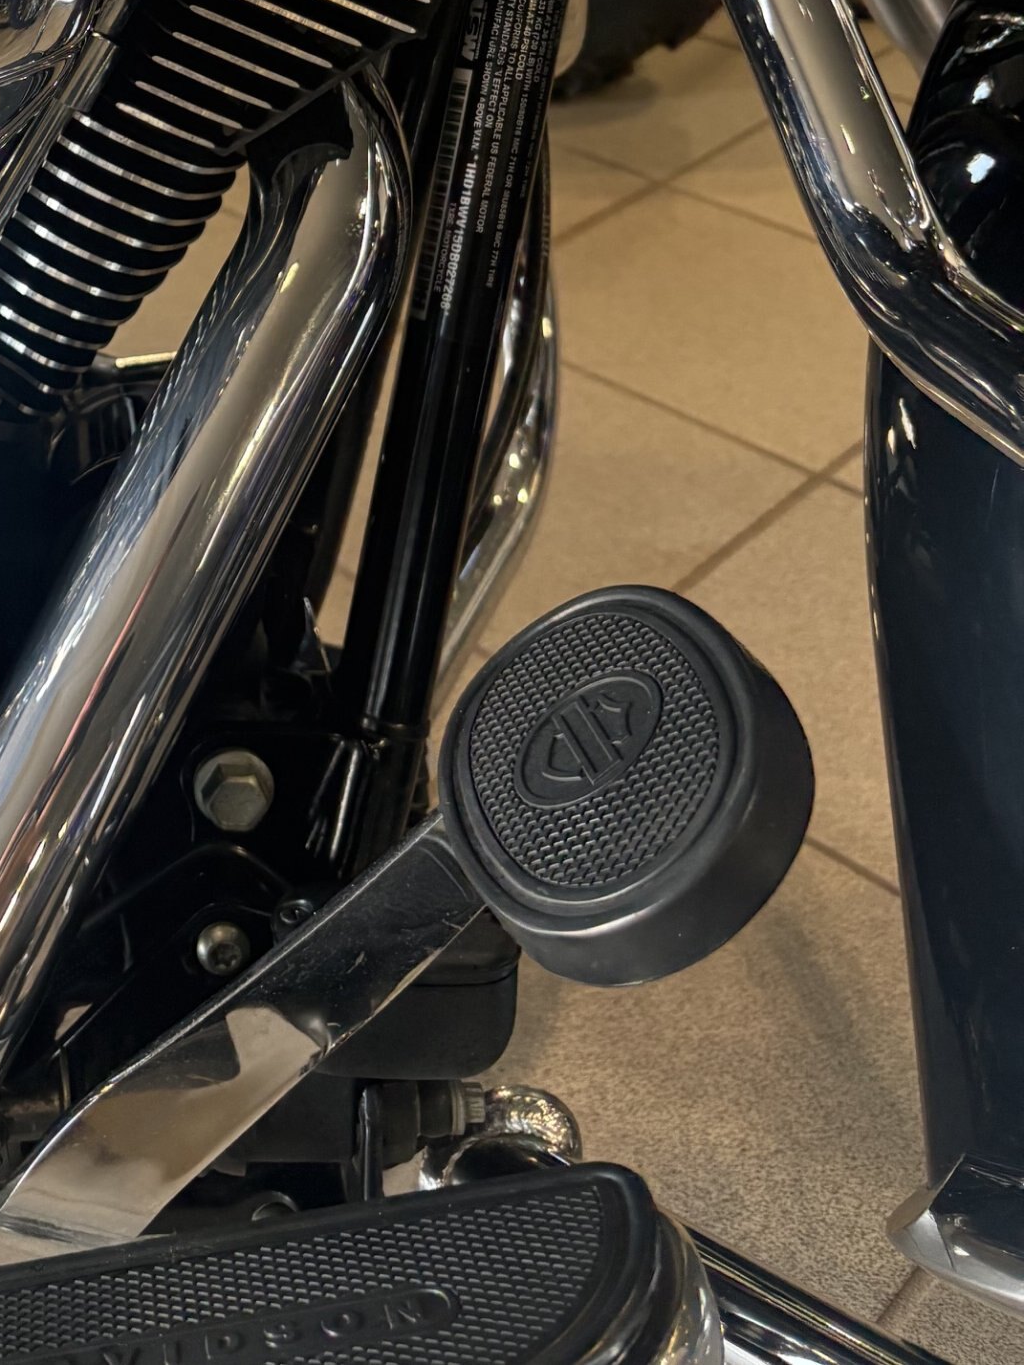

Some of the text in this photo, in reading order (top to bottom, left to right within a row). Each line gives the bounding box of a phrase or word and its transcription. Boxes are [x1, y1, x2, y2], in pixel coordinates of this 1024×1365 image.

[525, 11, 534, 24] AT
[533, 16, 543, 30] KG
[495, 9, 514, 66] STANDARDS
[519, 37, 529, 53] PSI
[506, 51, 516, 64] TO
[514, 53, 526, 80] COLD
[525, 50, 537, 67] LB)
[532, 56, 544, 83] COLD
[478, 60, 493, 95] SHOWN
[503, 64, 514, 82] ALL
[522, 67, 533, 91] WITH
[486, 77, 501, 113] EFFECT
[472, 96, 486, 129] ABOVE
[483, 113, 494, 128] ON
[491, 83, 510, 140] APPLICABLE
[489, 140, 500, 155] US
[480, 155, 497, 199] FEDERAL
[503, 173, 513, 188] OR
[474, 198, 489, 234] MOTOR
[432, 228, 452, 293] MOTORCYCLE
[484, 268, 495, 288] TIRE
